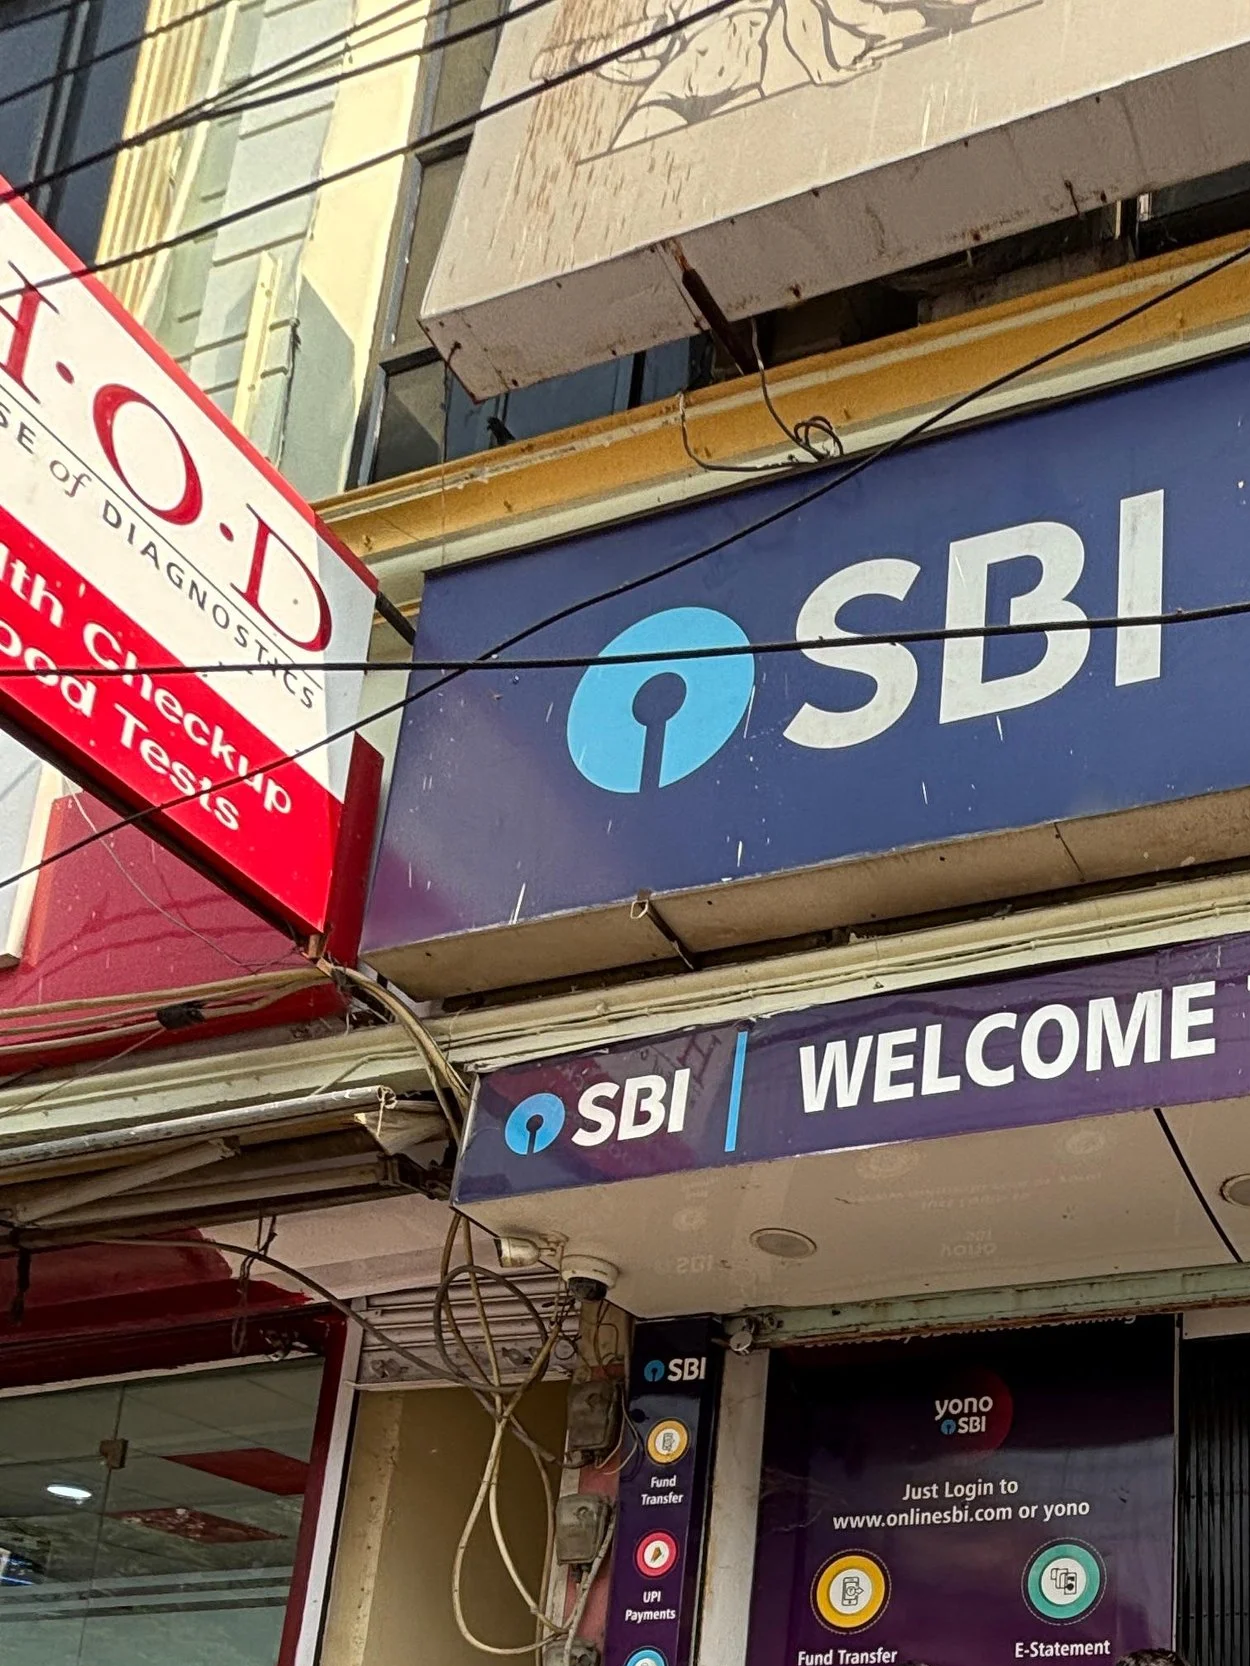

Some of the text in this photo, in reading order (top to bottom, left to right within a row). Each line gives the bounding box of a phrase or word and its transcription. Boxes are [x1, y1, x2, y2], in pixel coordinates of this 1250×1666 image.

[49, 460, 92, 498] of
[102, 499, 316, 710] DIAGNOSTICS
[782, 488, 1165, 750] SBI
[83, 622, 293, 814] Checkup
[113, 703, 240, 831] Tests
[799, 983, 1216, 1113] WELCOME
[571, 1067, 690, 1147] SBI
[667, 1357, 706, 1383] SBI
[934, 1395, 993, 1421] yono
[957, 1416, 986, 1435] SBI
[650, 1476, 676, 1489] Fund
[902, 1478, 1019, 1502] Just Login to
[641, 1491, 683, 1506] Transfer
[833, 1500, 1091, 1531] www.onlinesbi.com or yono
[643, 1591, 661, 1603] UPI
[625, 1608, 676, 1622] Payments
[798, 1647, 898, 1666] Fund Transfer
[1015, 1639, 1111, 1660] E-Statement
